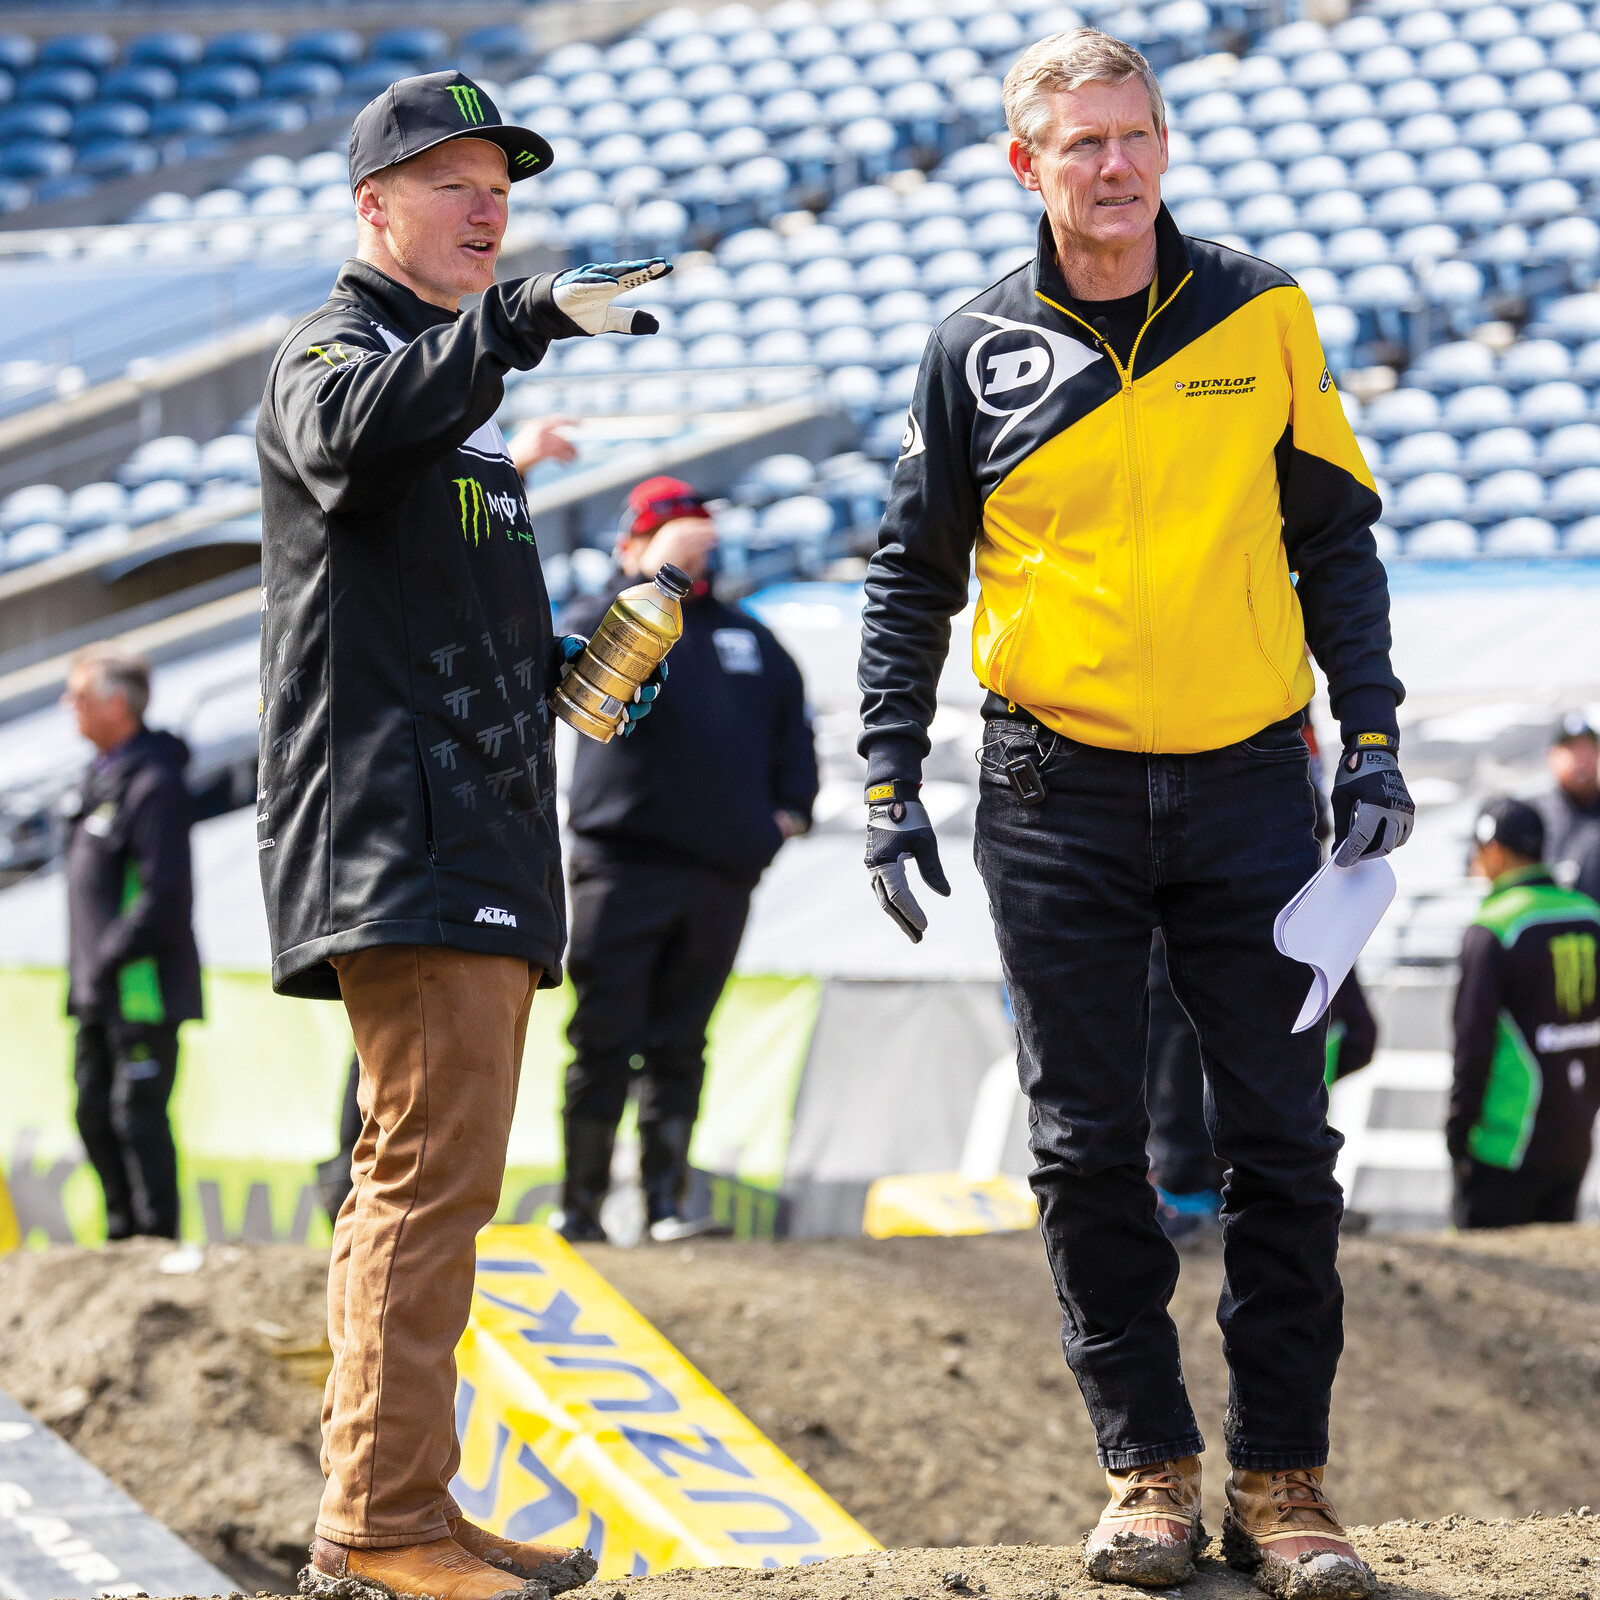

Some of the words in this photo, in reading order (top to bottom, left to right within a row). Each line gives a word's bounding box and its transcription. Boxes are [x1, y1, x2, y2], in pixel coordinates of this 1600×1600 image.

[984, 345, 1050, 396] D
[1185, 386, 1256, 398] MOTORSPORT
[1187, 376, 1257, 390] DUNLOP
[474, 906, 517, 928] KTM
[476, 1260, 825, 1568] UZUKI
